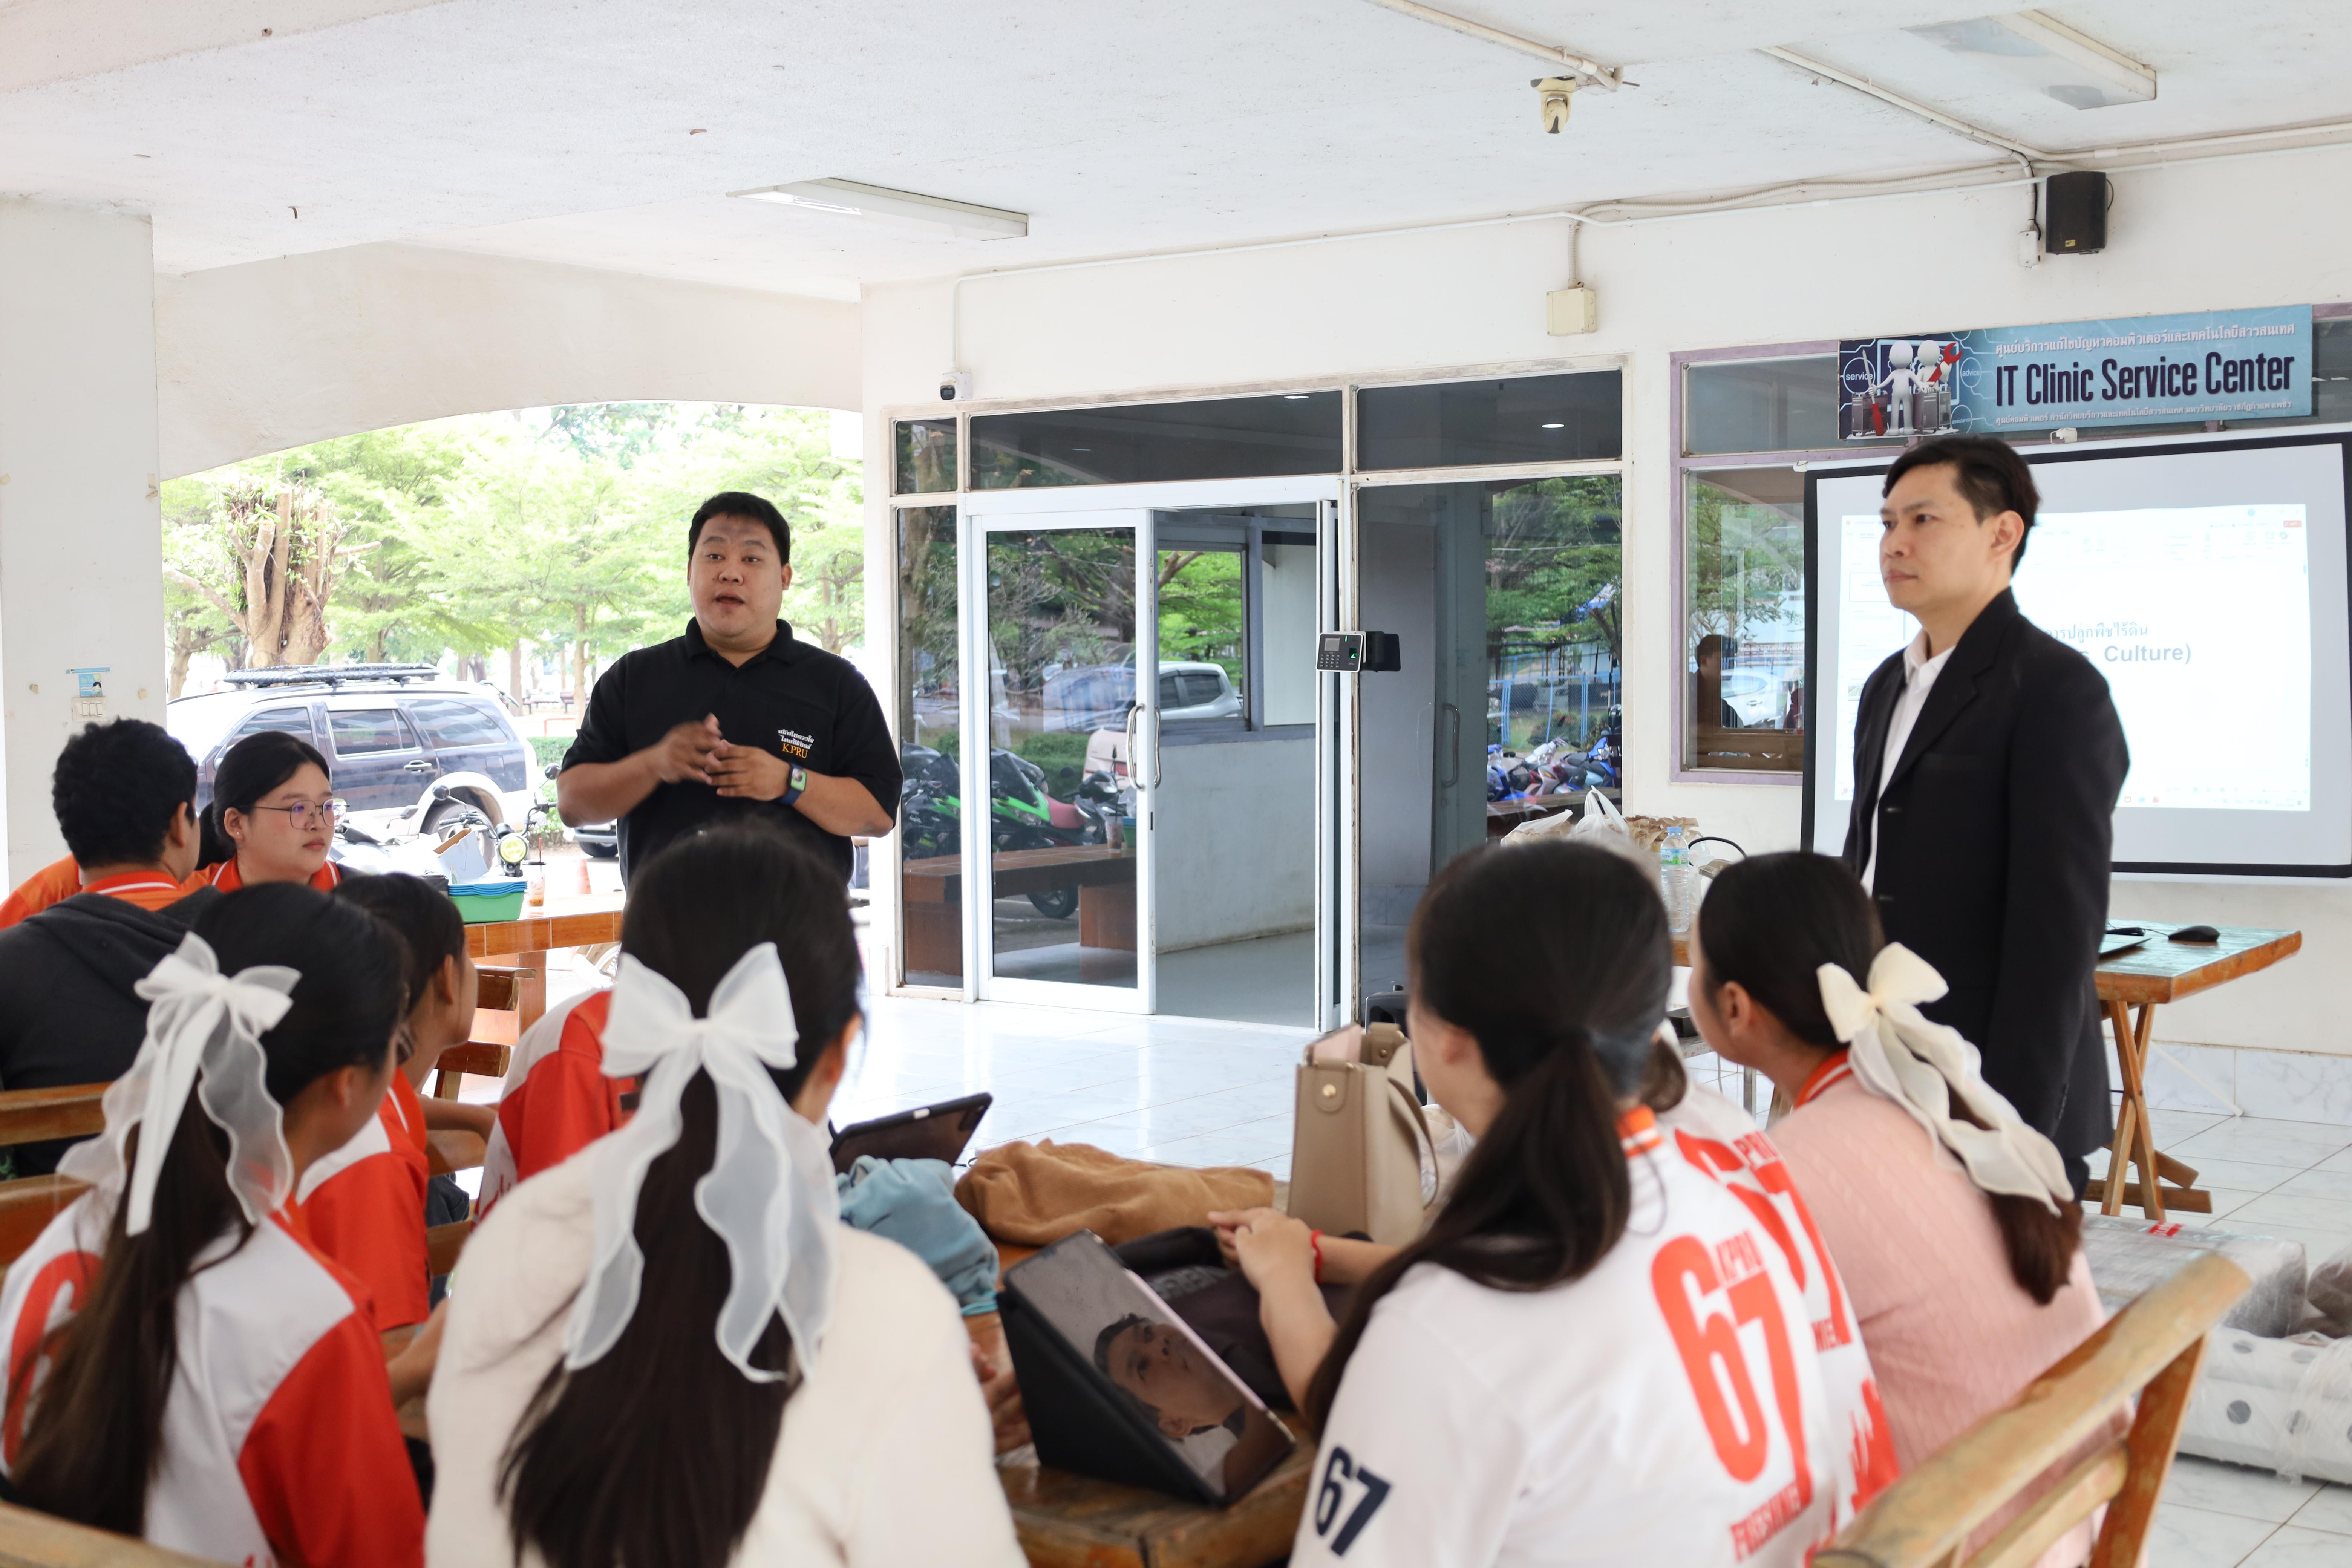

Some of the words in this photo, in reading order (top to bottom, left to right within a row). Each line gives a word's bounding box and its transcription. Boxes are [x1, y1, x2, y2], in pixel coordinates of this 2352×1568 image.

[1846, 372, 1873, 381] service
[1997, 365, 2018, 406] IT
[2026, 361, 2094, 404] Clinic
[2102, 358, 2197, 400] Service
[2206, 351, 2295, 394] Center
[2104, 643, 2191, 665] Culture)
[782, 743, 808, 758] KPRU
[1651, 1234, 1813, 1506] 67
[1316, 1447, 1392, 1556] 67
